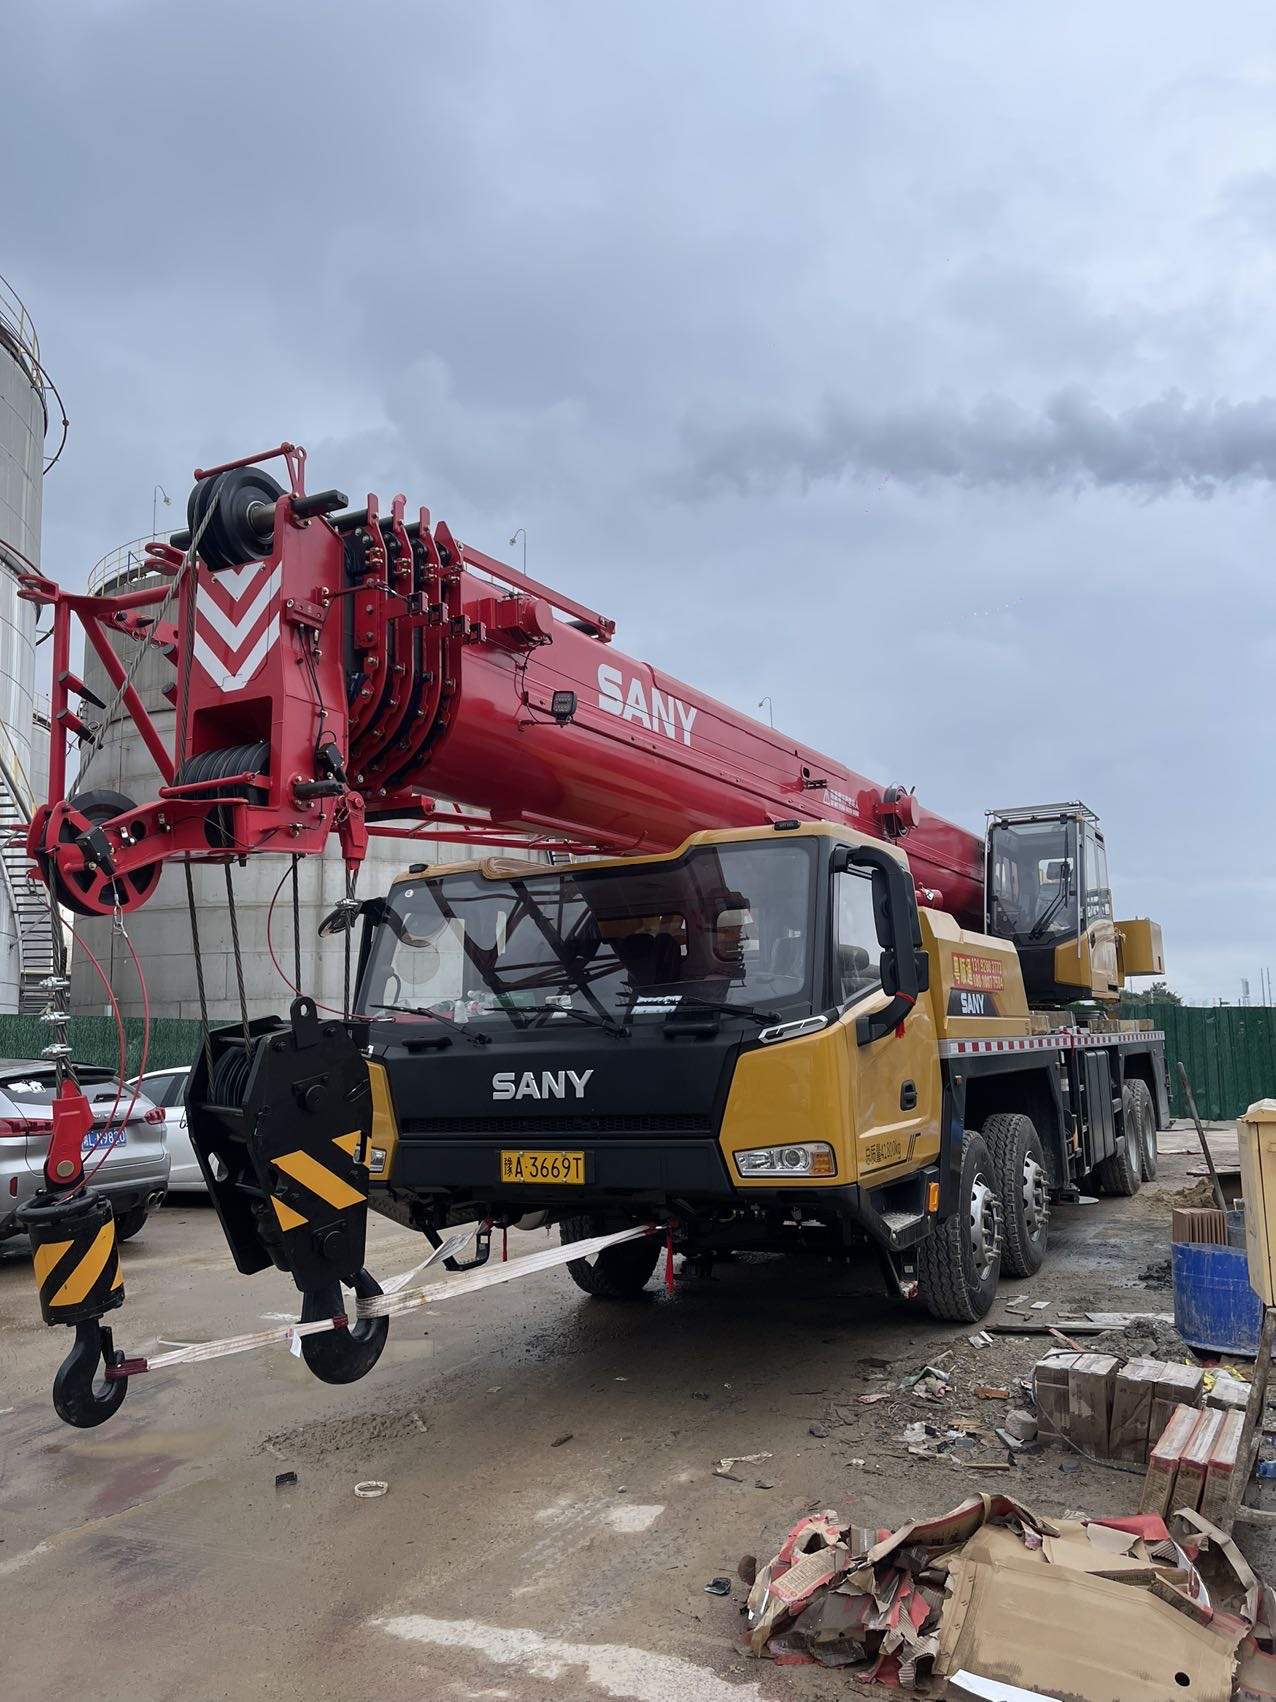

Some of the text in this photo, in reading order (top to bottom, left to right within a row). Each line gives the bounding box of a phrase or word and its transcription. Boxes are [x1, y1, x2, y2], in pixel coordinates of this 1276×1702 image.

[598, 665, 697, 746] SANY
[960, 992, 984, 1014] SANY
[492, 1069, 594, 1100] SANY
